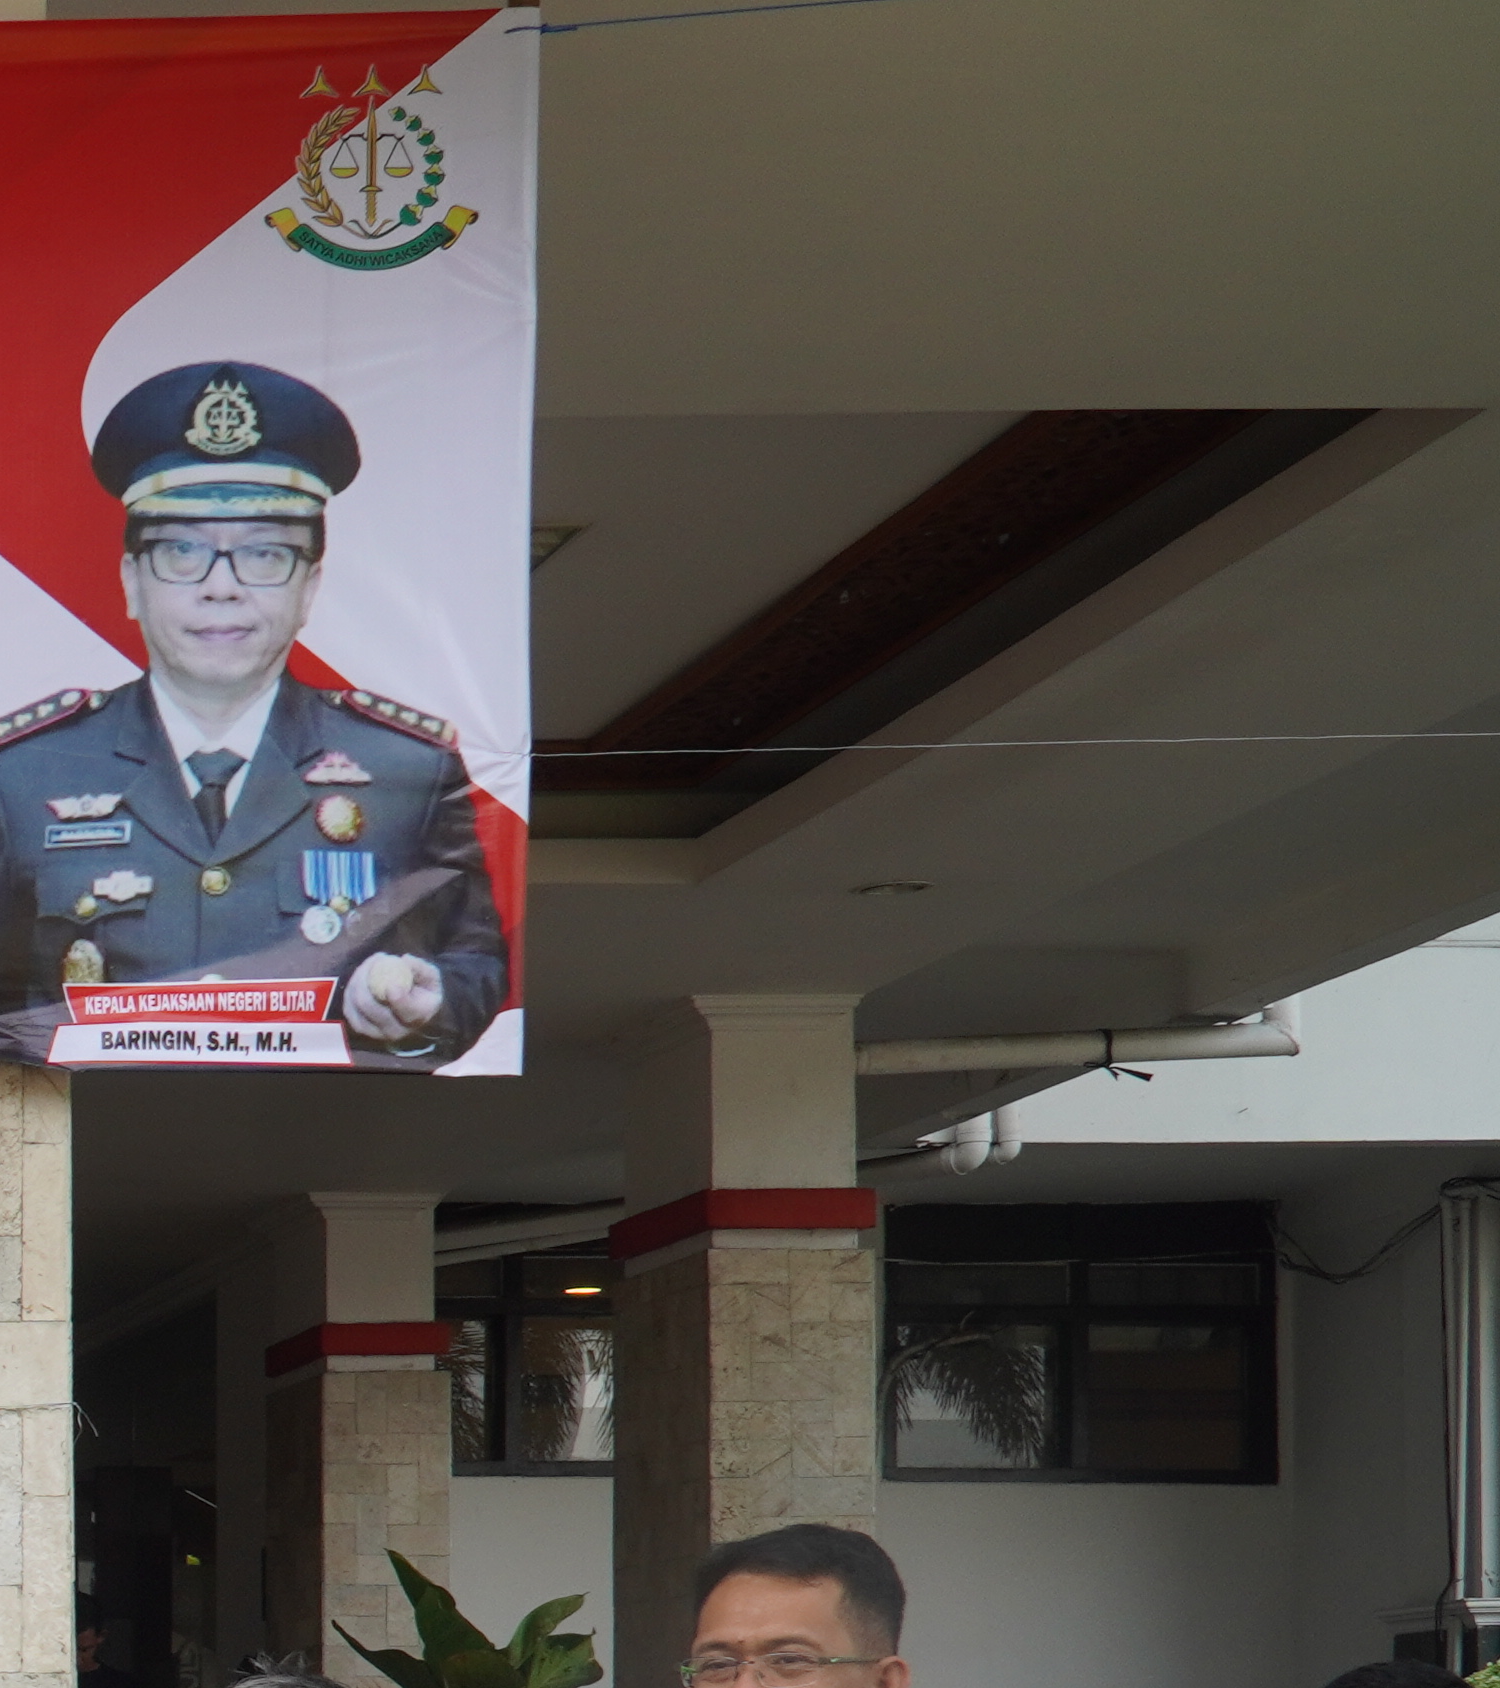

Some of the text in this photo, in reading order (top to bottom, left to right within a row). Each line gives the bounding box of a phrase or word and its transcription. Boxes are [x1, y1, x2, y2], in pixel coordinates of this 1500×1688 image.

[300, 231, 444, 267] SATYA ADHI WICAKSANA
[85, 990, 316, 1015] KEPALA KEJAKSAAN NEGERI BLITAR
[101, 1030, 298, 1055] BARINGIN, S.H., M.H.
